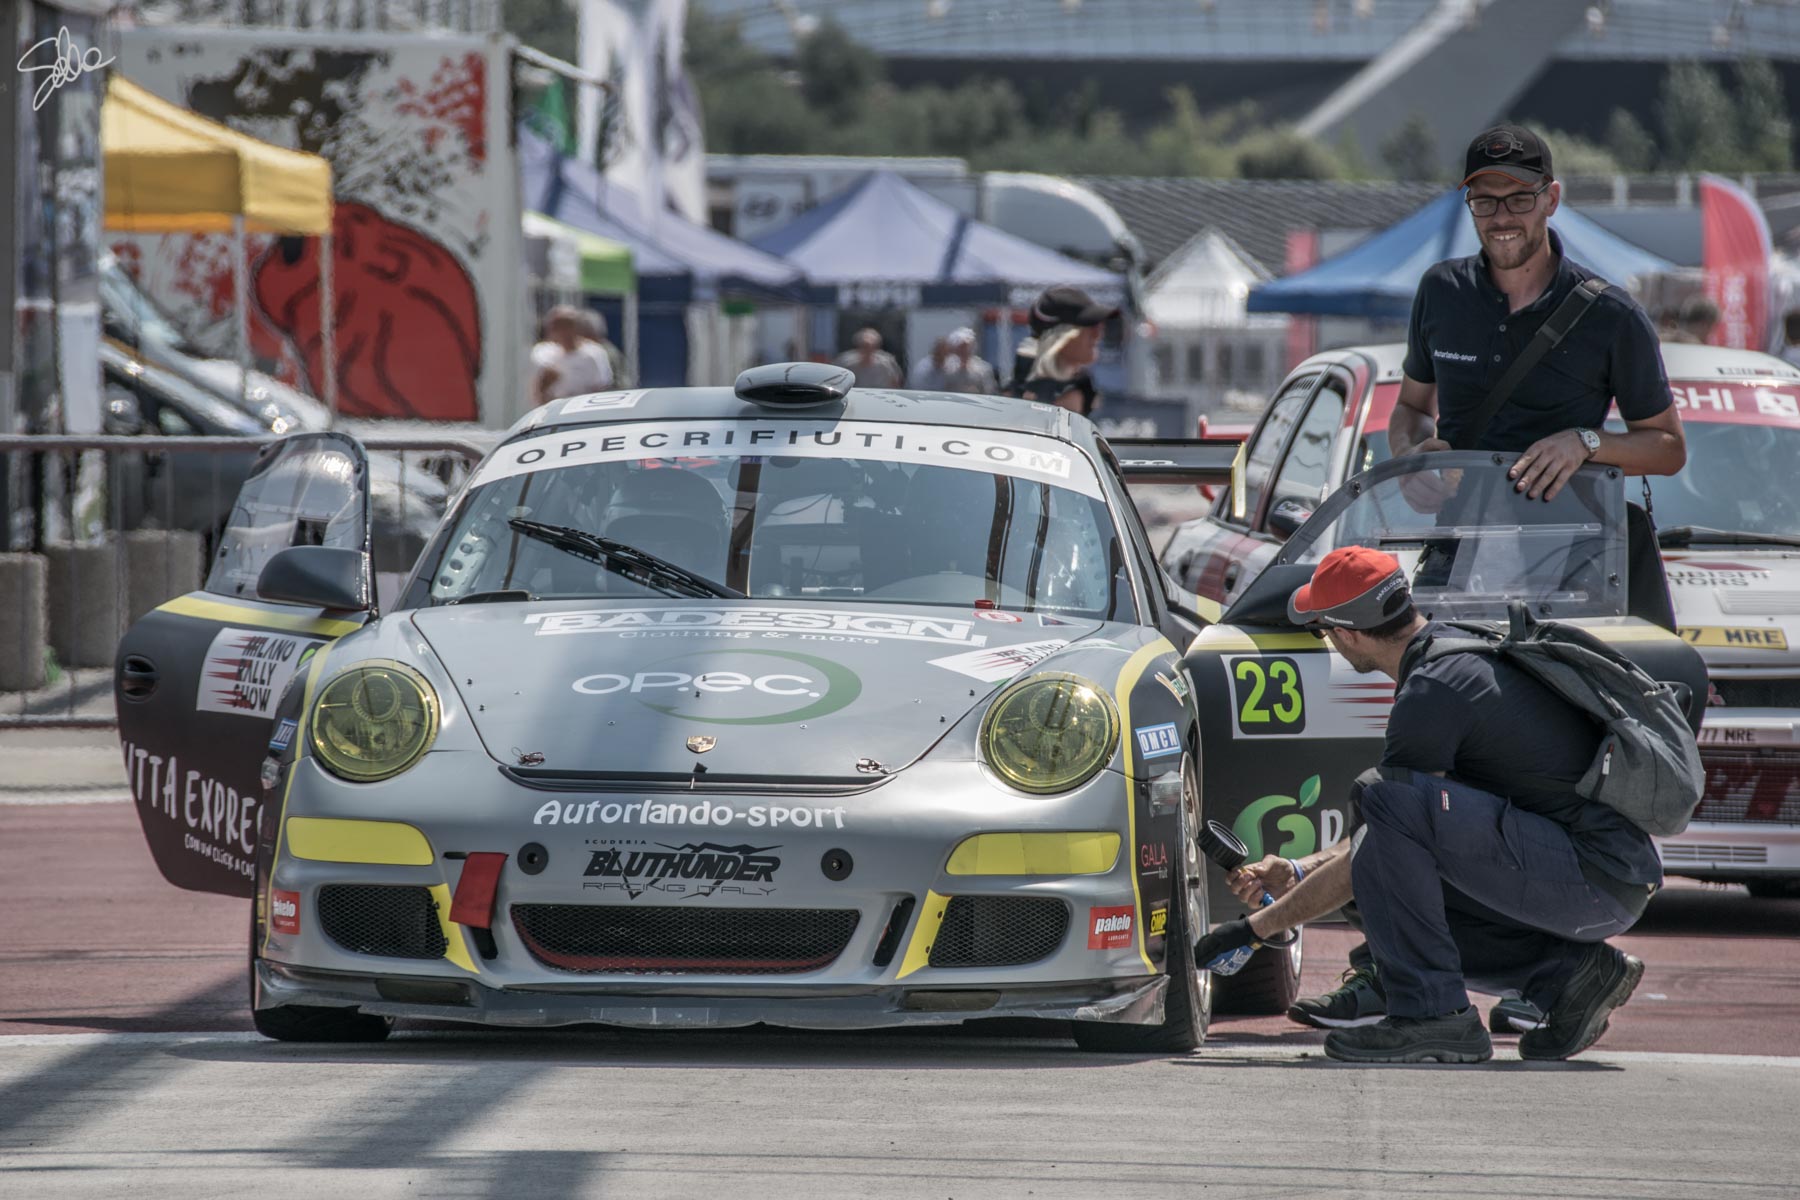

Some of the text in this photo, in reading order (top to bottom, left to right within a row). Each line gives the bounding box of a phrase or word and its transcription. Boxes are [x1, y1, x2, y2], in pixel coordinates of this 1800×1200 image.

[515, 430, 1064, 474] OPECRIFIUTI.COM
[540, 608, 974, 645] BADESIGN
[618, 630, 879, 645] Clothing & more
[240, 636, 297, 663] MILANO
[236, 659, 278, 687] RALLY
[232, 684, 273, 712] SHOW
[1236, 660, 1303, 724] 23
[184, 770, 264, 854] EXPRE
[532, 799, 847, 829] Autorlando-sport
[582, 849, 782, 883] BLUTHUNDER
[1141, 842, 1169, 867] GALA
[582, 882, 777, 896] RACING ITALY
[1095, 913, 1131, 935] pakelo
